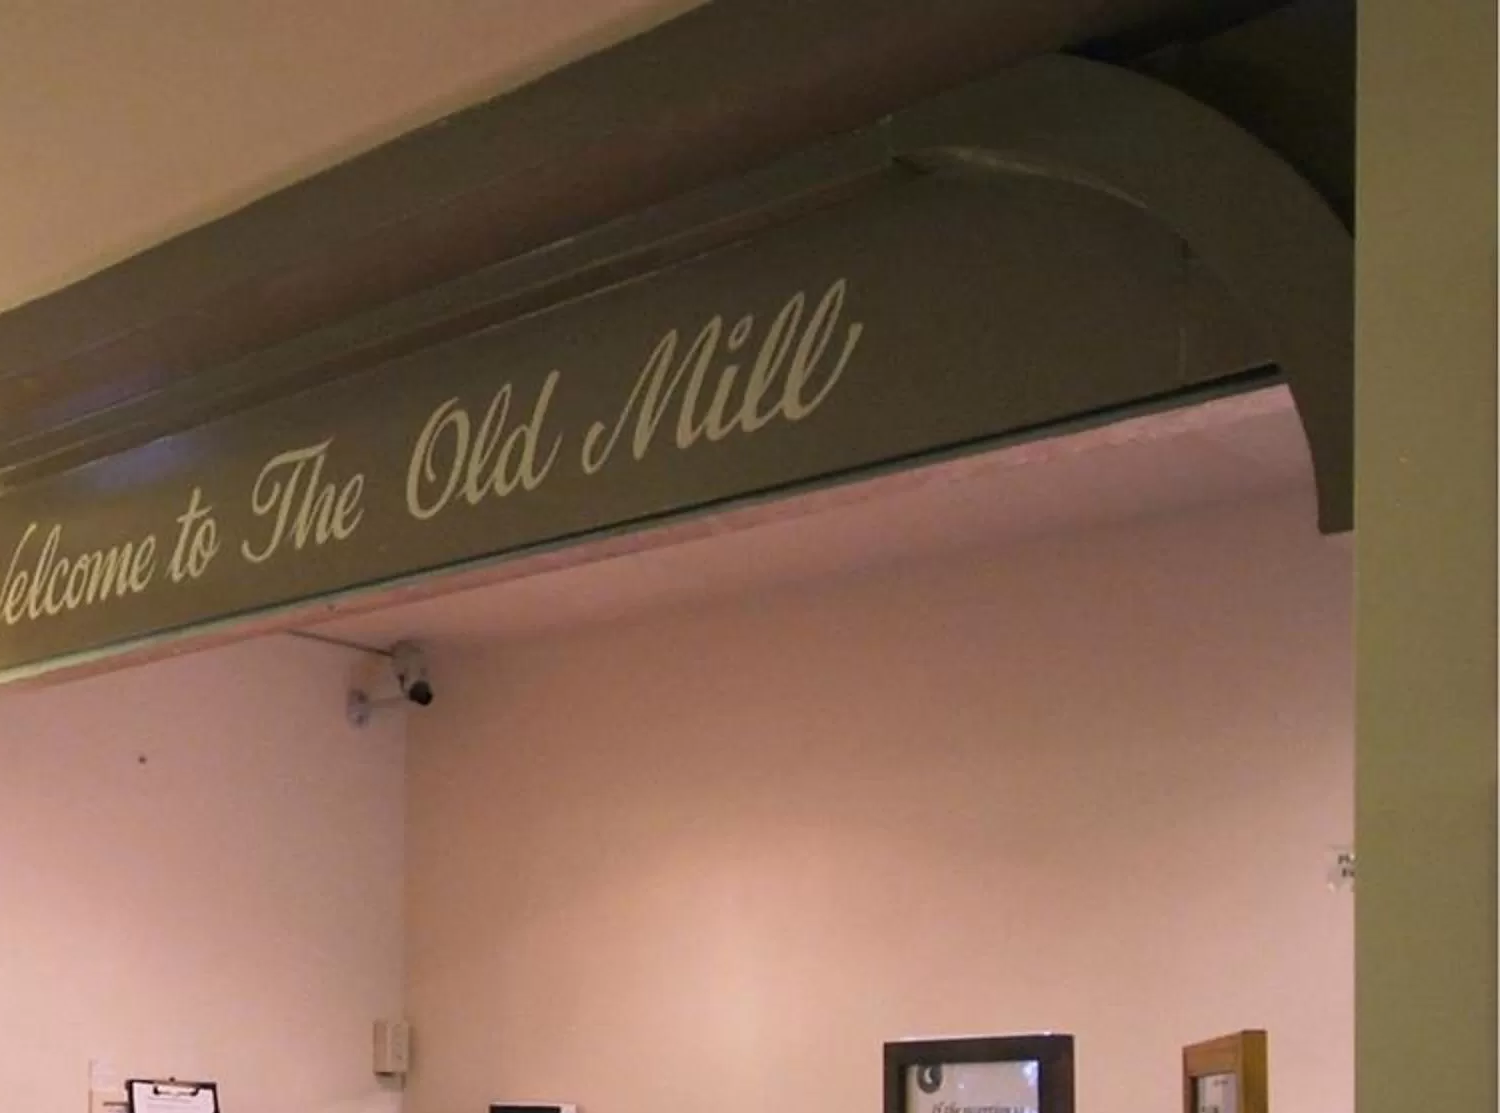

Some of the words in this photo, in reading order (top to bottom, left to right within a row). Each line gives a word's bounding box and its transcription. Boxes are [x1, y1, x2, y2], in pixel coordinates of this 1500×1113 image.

[167, 486, 221, 583] to
[241, 436, 365, 563] The
[406, 370, 563, 519] Old
[582, 278, 864, 474] Mill
